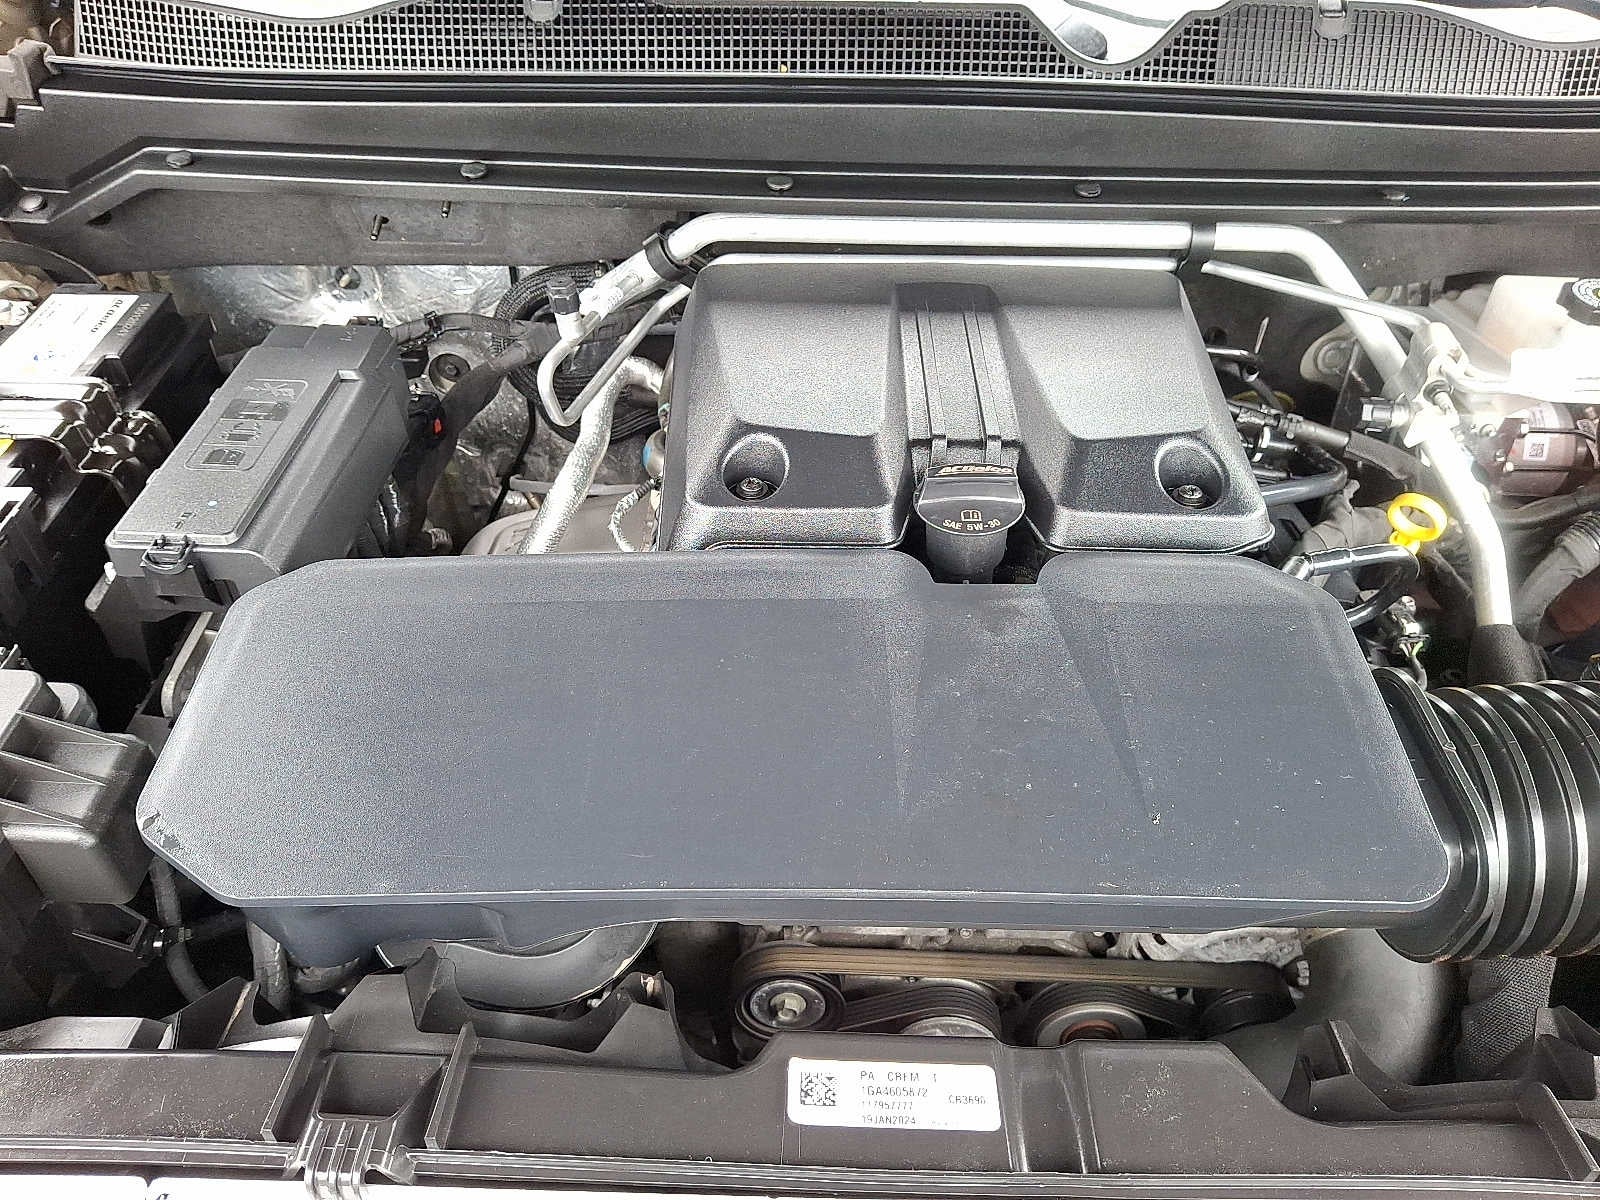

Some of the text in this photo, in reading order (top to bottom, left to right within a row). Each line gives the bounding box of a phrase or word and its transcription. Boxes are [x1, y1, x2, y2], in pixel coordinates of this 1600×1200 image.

[943, 518, 1001, 531] SAE 5W-30
[860, 1070, 875, 1080] PA
[861, 1114, 917, 1125] 19JAN2024
